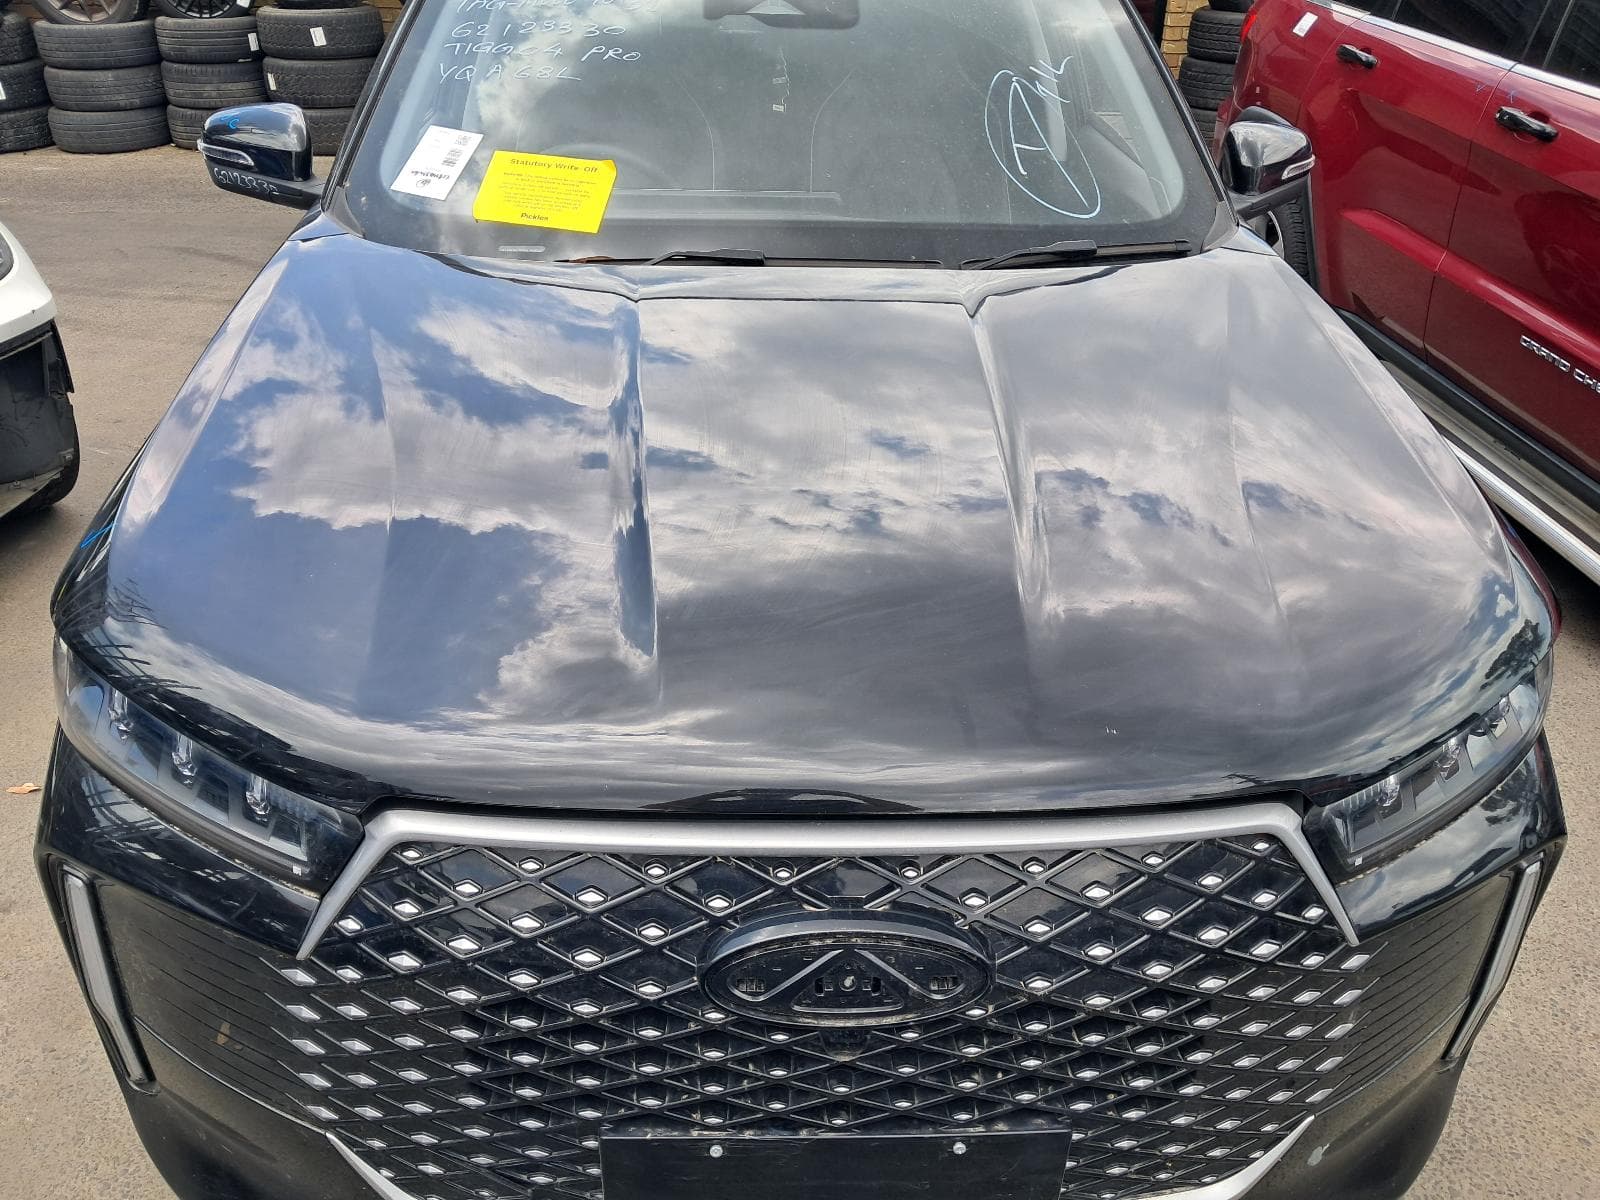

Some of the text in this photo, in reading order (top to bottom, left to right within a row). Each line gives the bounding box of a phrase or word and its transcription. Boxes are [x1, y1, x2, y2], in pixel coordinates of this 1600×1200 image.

[580, 45, 641, 62] PRO
[510, 158, 553, 169] Statutory
[1519, 334, 1571, 373] GRAND
